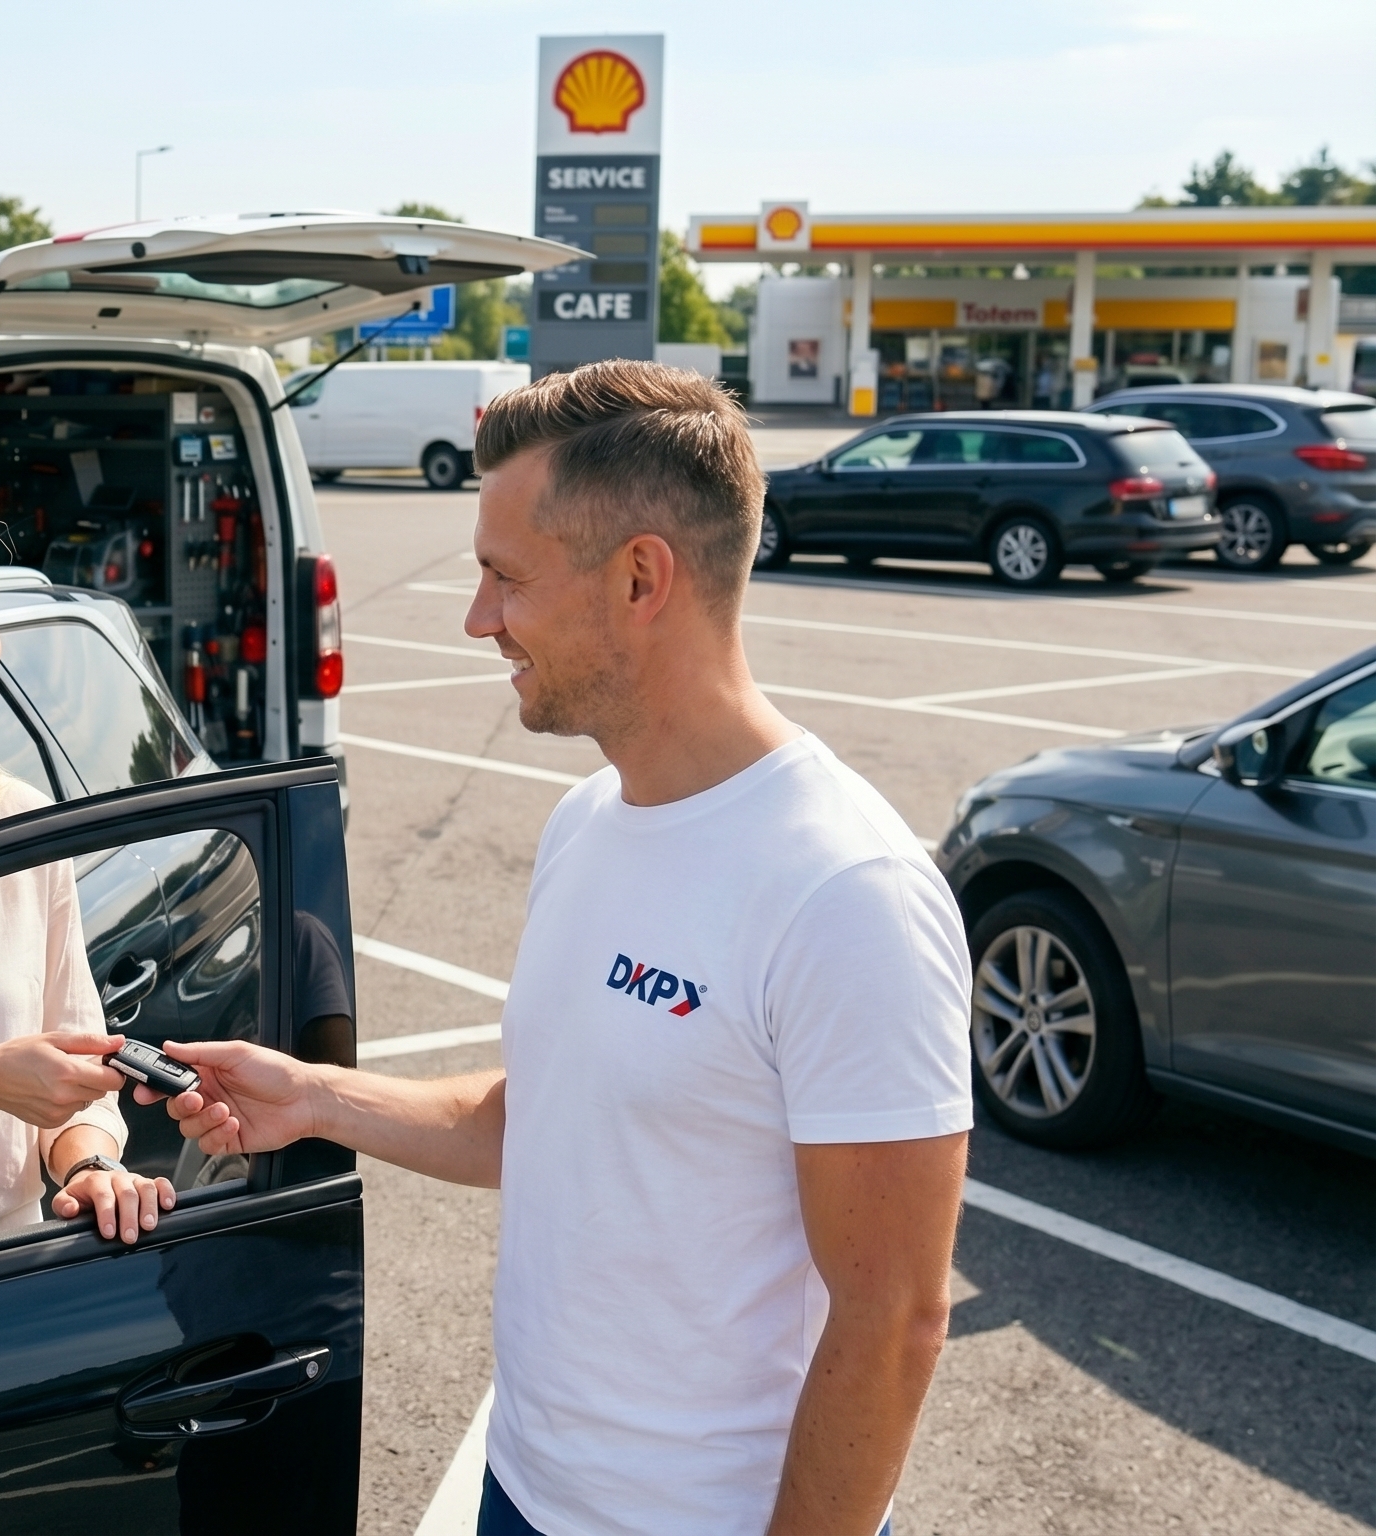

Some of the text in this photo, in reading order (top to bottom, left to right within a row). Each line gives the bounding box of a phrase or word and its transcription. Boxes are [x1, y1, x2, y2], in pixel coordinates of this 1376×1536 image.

[548, 166, 646, 190] SERVICE
[554, 292, 632, 319] CAFE
[963, 302, 1037, 322] Totem
